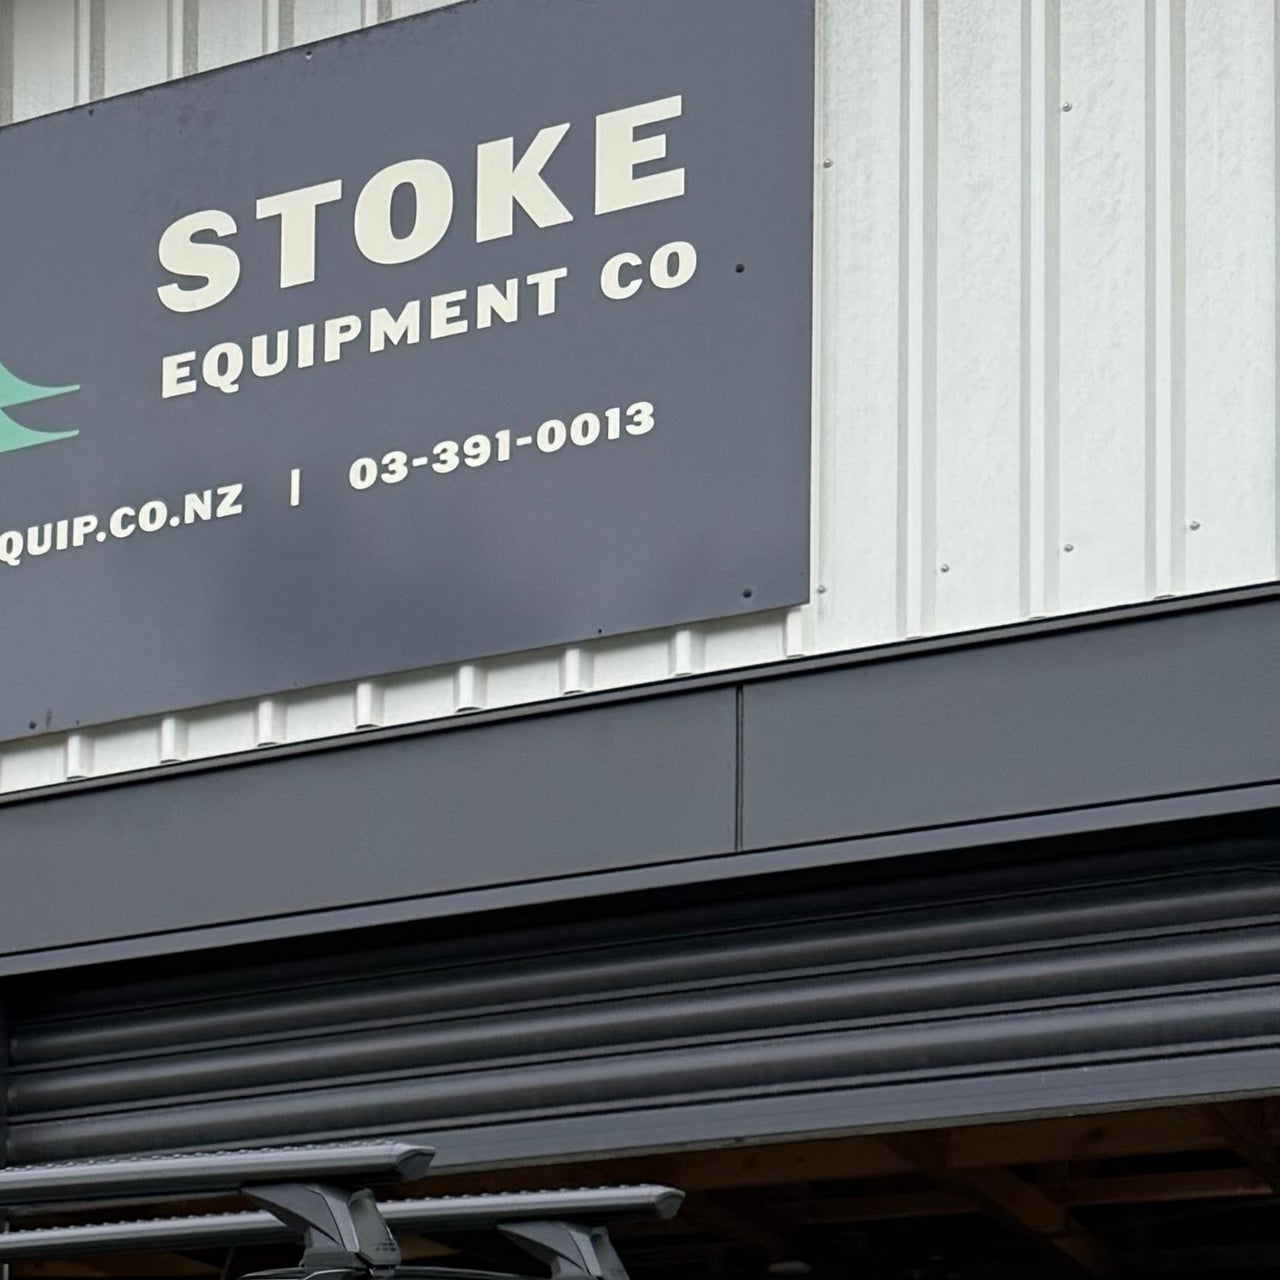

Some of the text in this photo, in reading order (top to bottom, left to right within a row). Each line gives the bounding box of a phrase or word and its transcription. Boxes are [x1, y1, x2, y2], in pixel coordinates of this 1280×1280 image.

[156, 94, 686, 314] STOKE
[161, 240, 698, 400] EQUIPMENT CO
[348, 401, 656, 491] 03-391-0013
